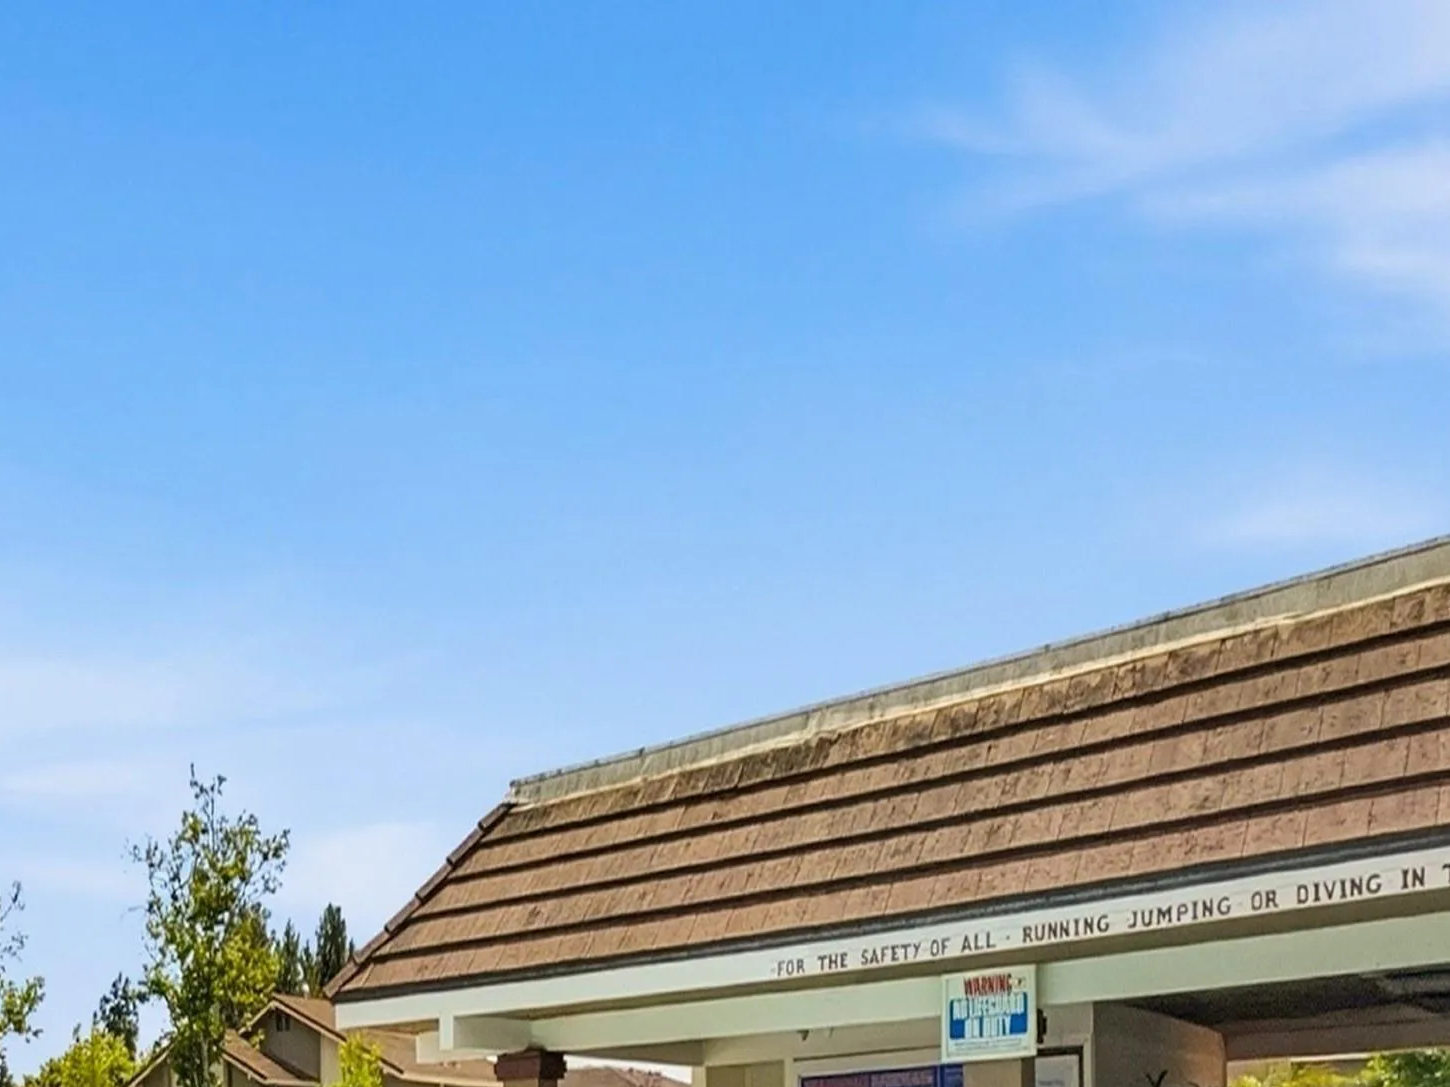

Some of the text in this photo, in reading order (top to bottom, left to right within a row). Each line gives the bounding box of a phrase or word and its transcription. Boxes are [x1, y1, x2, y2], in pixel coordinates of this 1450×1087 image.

[776, 959, 805, 977] FOR
[817, 952, 848, 972] THE
[860, 941, 922, 966] SAFETY
[929, 937, 951, 957] OF
[960, 931, 997, 954] ALL
[1021, 914, 1110, 943] RUNNING
[1127, 896, 1233, 929] JUMPING
[1250, 889, 1279, 911] OR
[1296, 873, 1383, 905] DIVING
[1400, 866, 1426, 890] IN
[982, 1014, 1012, 1037] DUTY
